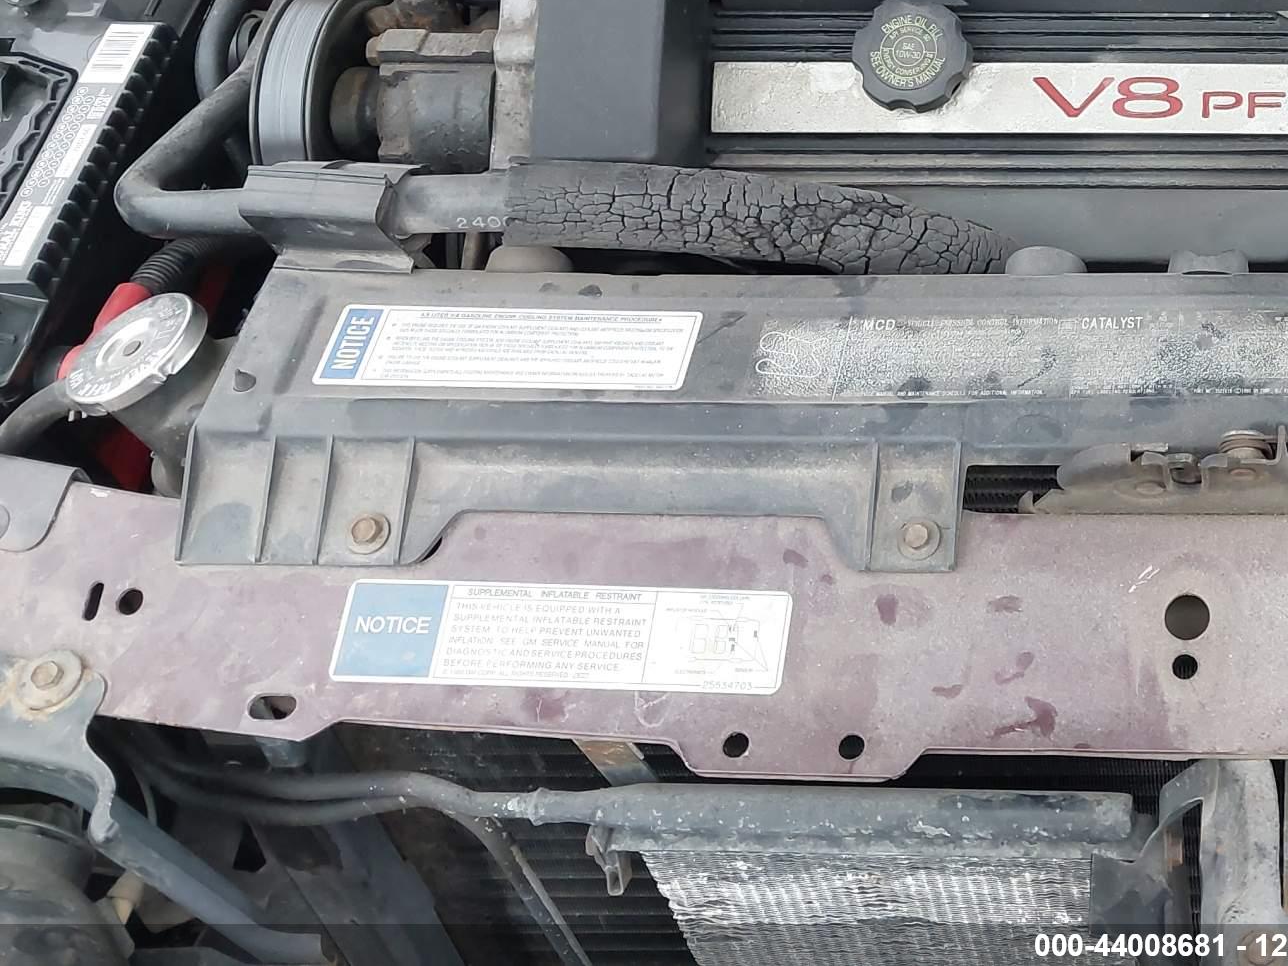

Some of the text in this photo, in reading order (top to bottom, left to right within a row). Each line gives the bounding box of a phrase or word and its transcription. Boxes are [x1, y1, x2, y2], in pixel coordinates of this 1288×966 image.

[881, 15, 913, 34] ENGINE
[914, 16, 928, 30] OIL
[896, 50, 921, 59] 10W-30
[870, 51, 946, 88] SEE OWNER'S MANUAL
[1033, 76, 1183, 119] V8
[1081, 316, 1143, 330] CATALYST
[331, 316, 375, 369] NOTICE
[467, 588, 643, 601] SUPPLEMENTAL INFLATABLE RESTRAINT
[536, 604, 585, 613] EQUIPPED
[354, 615, 431, 634] NOTICE
[453, 613, 647, 626] SUPPLEMENTAL INFLATABLE RESTRAINT
[539, 627, 585, 636] PREVENT
[586, 628, 641, 638] UNWANTED
[541, 638, 580, 647] SERVICE
[584, 639, 620, 649] MANUAL
[625, 641, 644, 650] FOR
[510, 648, 529, 657] AND
[530, 649, 573, 659] SERVICE
[574, 650, 643, 661] PROCEDURES
[555, 661, 574, 670] ANY
